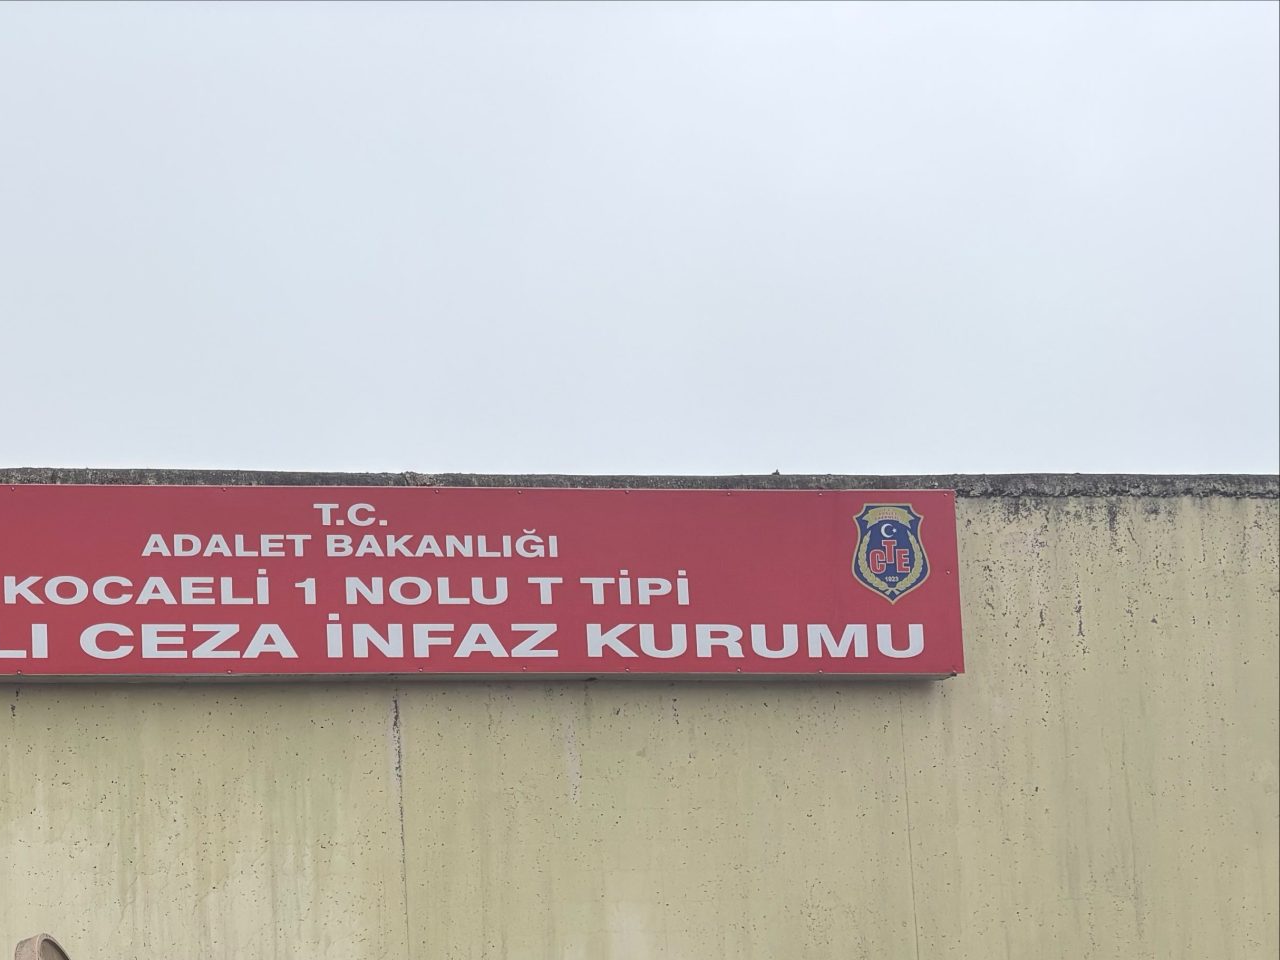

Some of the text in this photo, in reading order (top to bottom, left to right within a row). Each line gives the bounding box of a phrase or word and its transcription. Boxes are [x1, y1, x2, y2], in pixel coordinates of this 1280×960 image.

[313, 502, 388, 527] T.C.
[141, 526, 558, 558] ADALET BAKANLIĞI
[869, 540, 911, 574] CTE
[3, 568, 690, 606] KOCAELİ 1 NOLU T TİPİ
[79, 622, 299, 660] CEZA
[326, 613, 559, 659] İNFAZ
[586, 623, 925, 660] KURUMU
